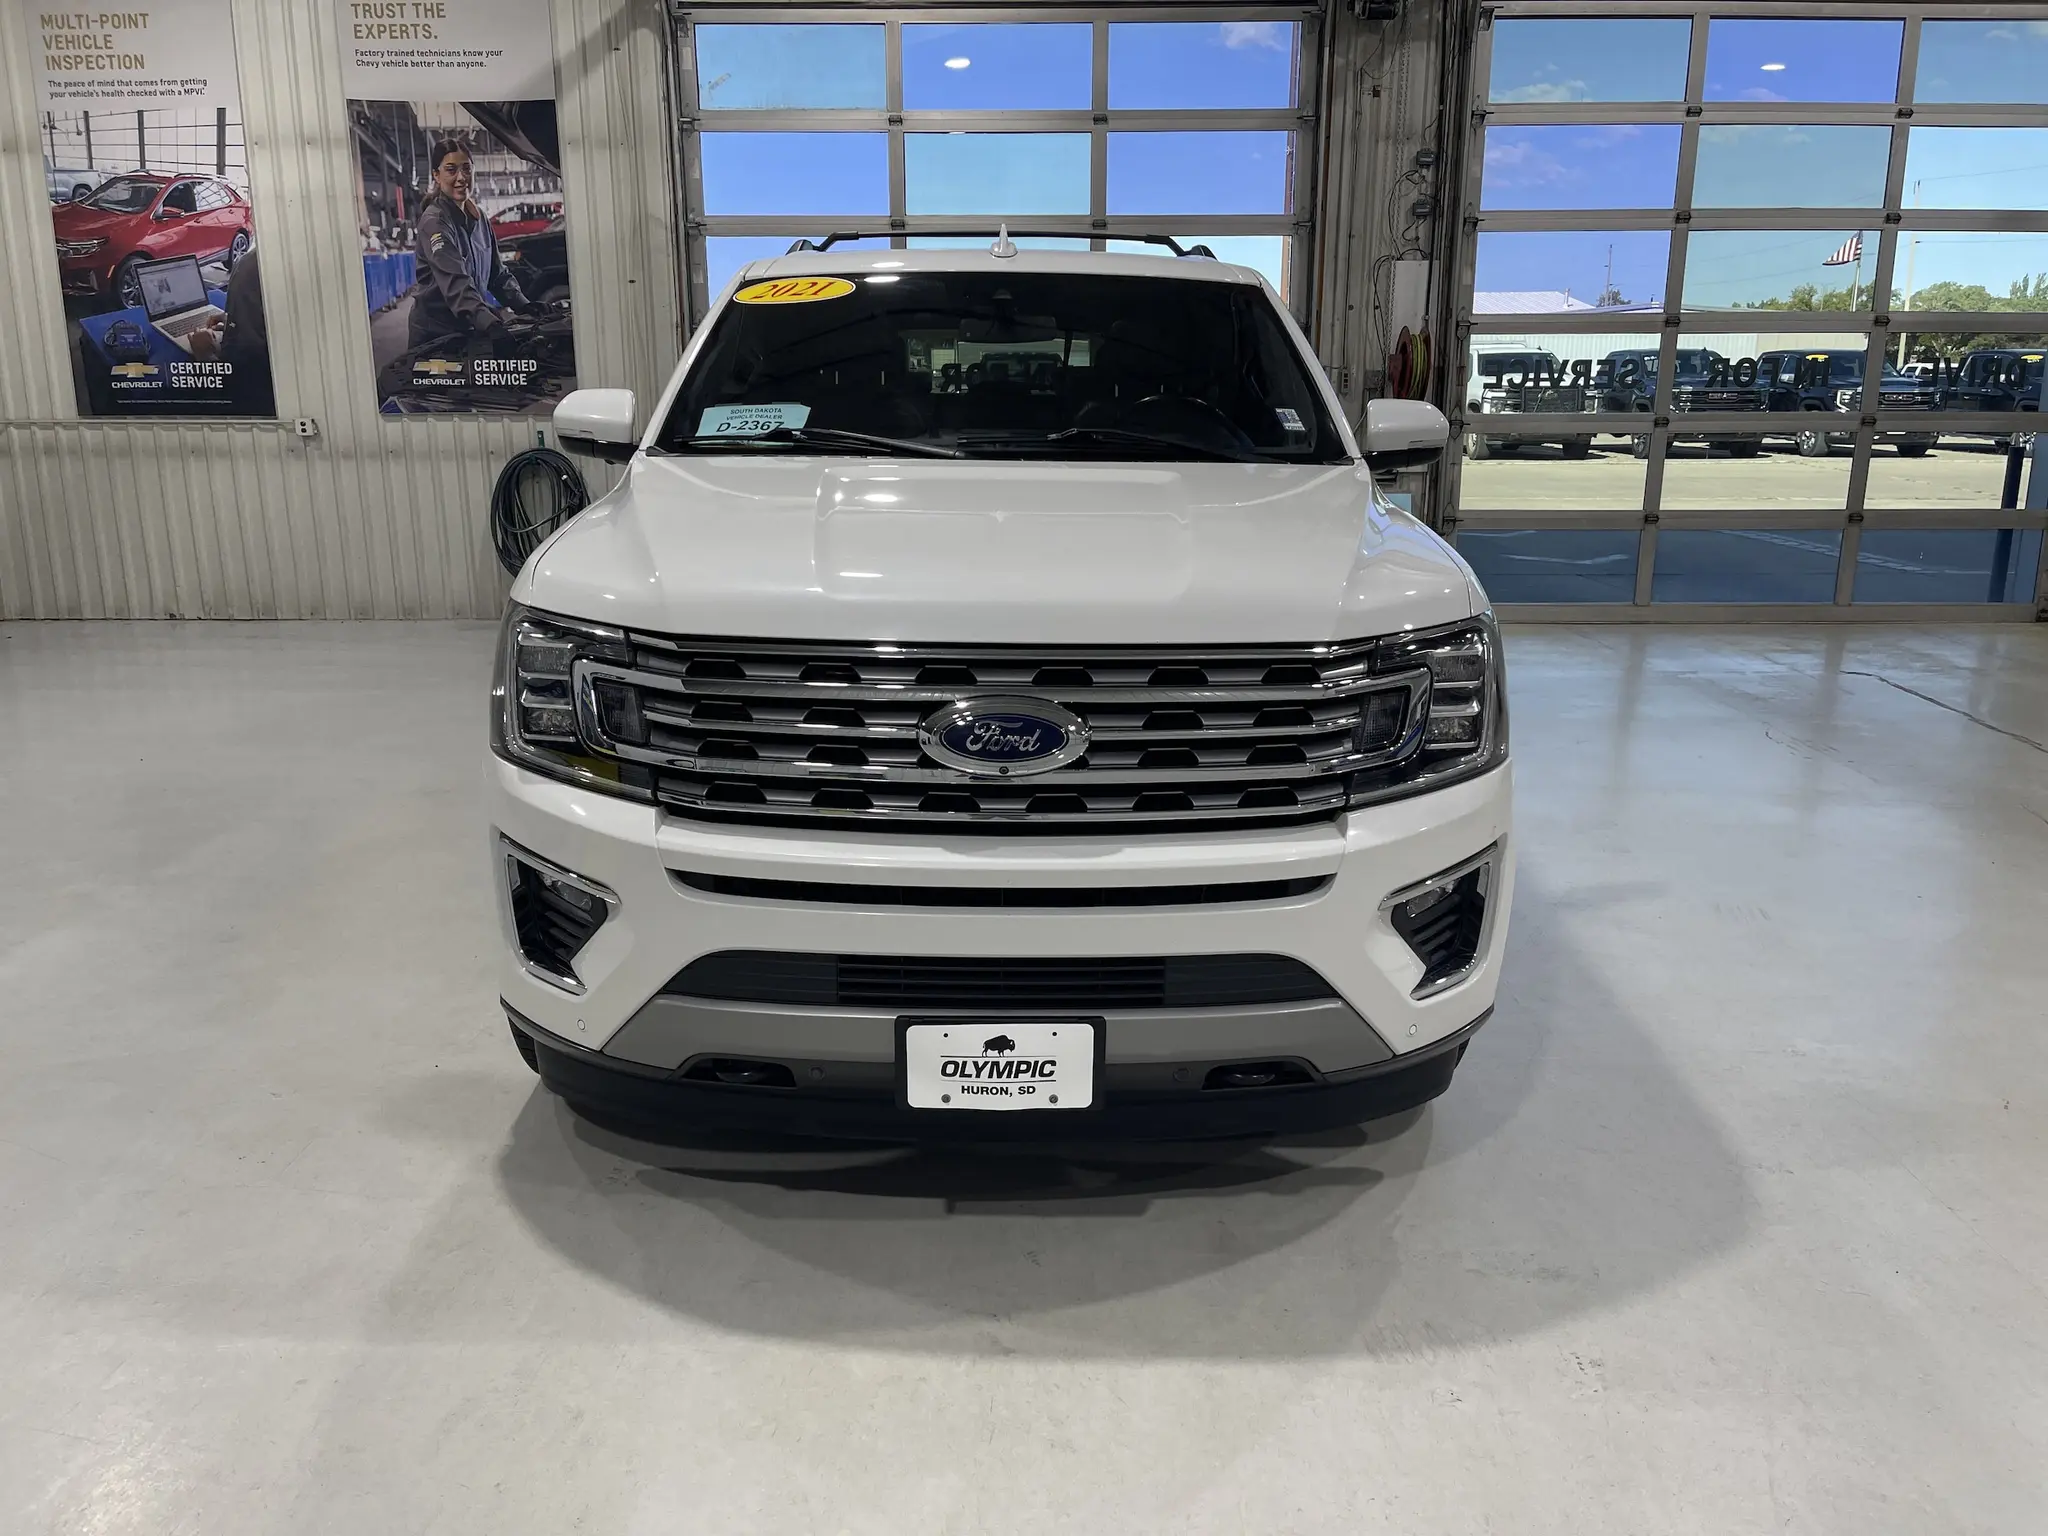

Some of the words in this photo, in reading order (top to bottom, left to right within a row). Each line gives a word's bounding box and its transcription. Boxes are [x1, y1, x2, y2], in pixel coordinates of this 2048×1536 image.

[351, 3, 406, 19] TRUST
[413, 2, 446, 19] THE
[40, 13, 149, 30] MULTI-POINT
[354, 23, 439, 40] EXPERTS.
[43, 34, 114, 50] VEHICLE
[355, 49, 385, 58] Factory
[386, 49, 415, 57] trained
[416, 49, 461, 57] technicians
[463, 49, 483, 57] know
[485, 50, 503, 58] your
[45, 54, 145, 71] INSPECTION
[356, 59, 379, 68] Chevy
[381, 59, 409, 67] vehicle
[457, 61, 487, 69] anyone.
[48, 80, 62, 88] The
[64, 81, 86, 89] peace
[117, 79, 133, 87] that
[180, 78, 207, 88] getting
[49, 91, 66, 99] your
[126, 89, 158, 97] checked
[159, 88, 176, 96] with
[748, 282, 837, 300] 2021
[170, 362, 233, 374] CERTIFIED
[473, 359, 537, 372] CERTIFIED
[171, 376, 224, 388] SERVICE
[474, 373, 528, 385] SERVICE
[716, 420, 784, 432] D-2367
[966, 720, 1041, 752] Ford
[940, 1060, 1056, 1079] OLYMPIC
[961, 1085, 1013, 1097] HURON,
[1018, 1085, 1036, 1095] SD
